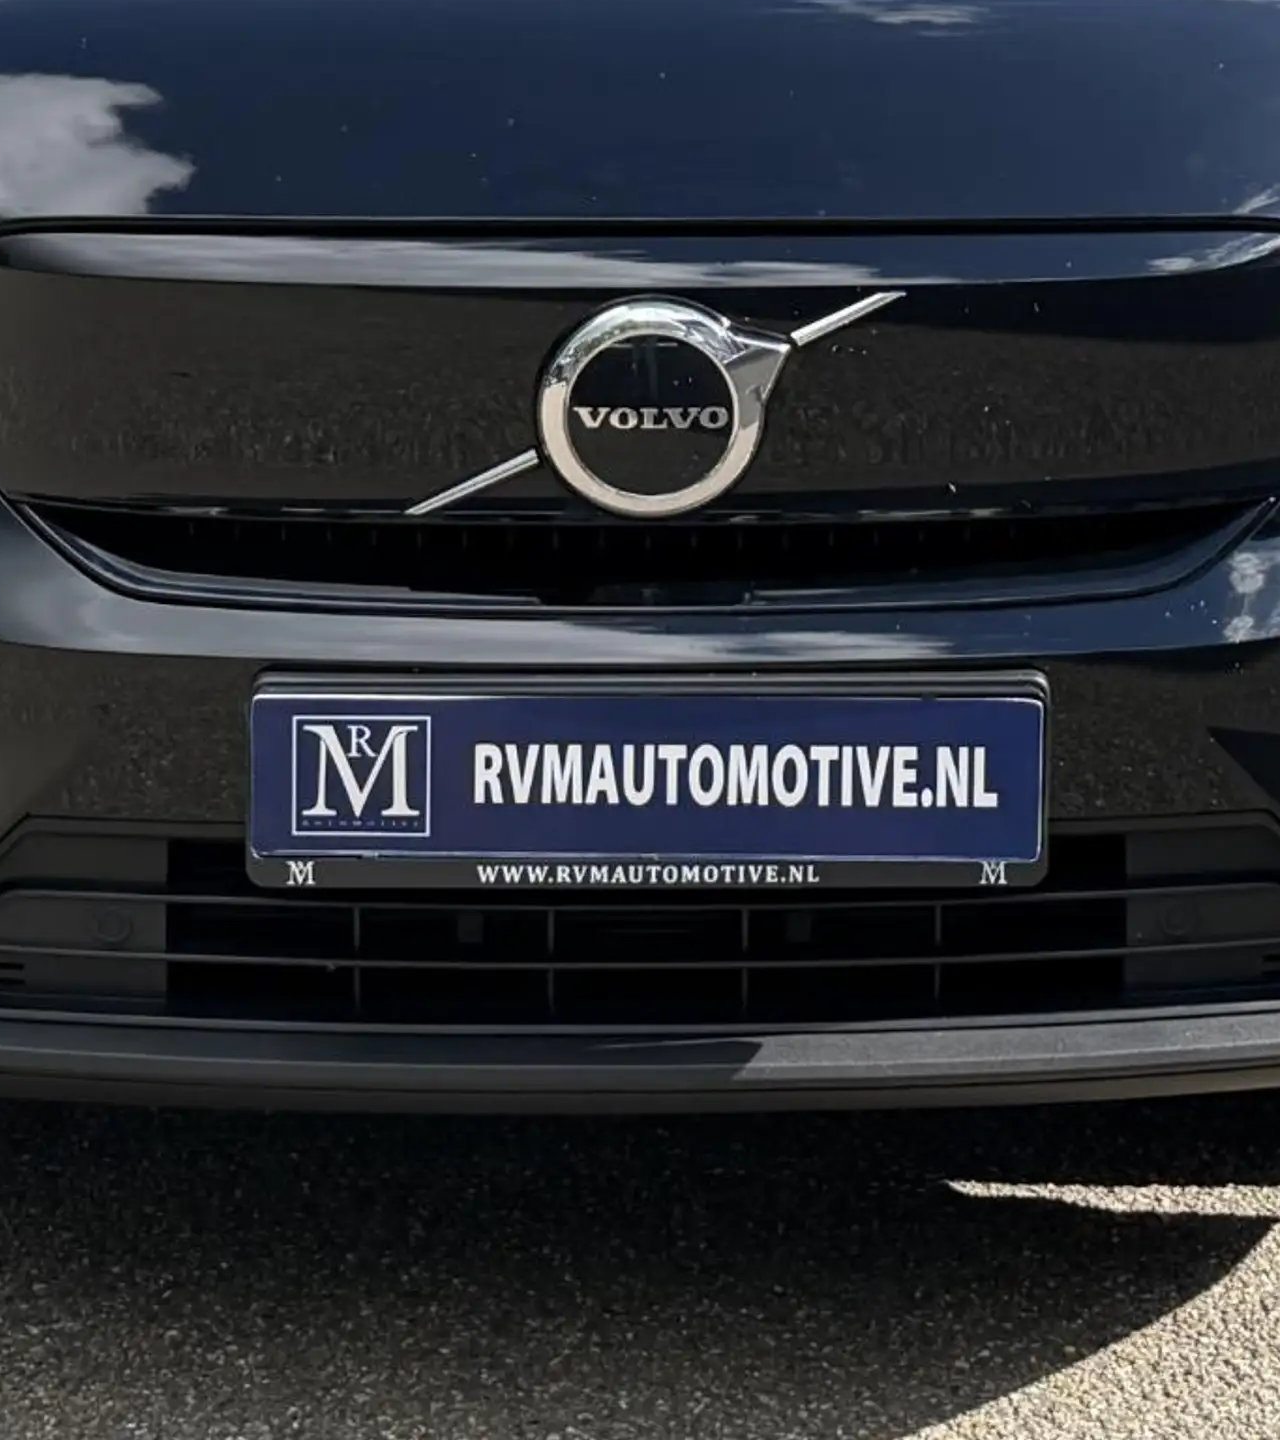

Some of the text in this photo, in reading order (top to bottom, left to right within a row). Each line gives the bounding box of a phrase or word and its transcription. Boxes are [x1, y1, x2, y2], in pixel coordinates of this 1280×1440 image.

[572, 406, 730, 430] VOLVO
[473, 743, 999, 808] RVMAUTOMOTIVE.NL
[476, 864, 821, 885] WWW.RVMAUTOMOTIVE.NL
